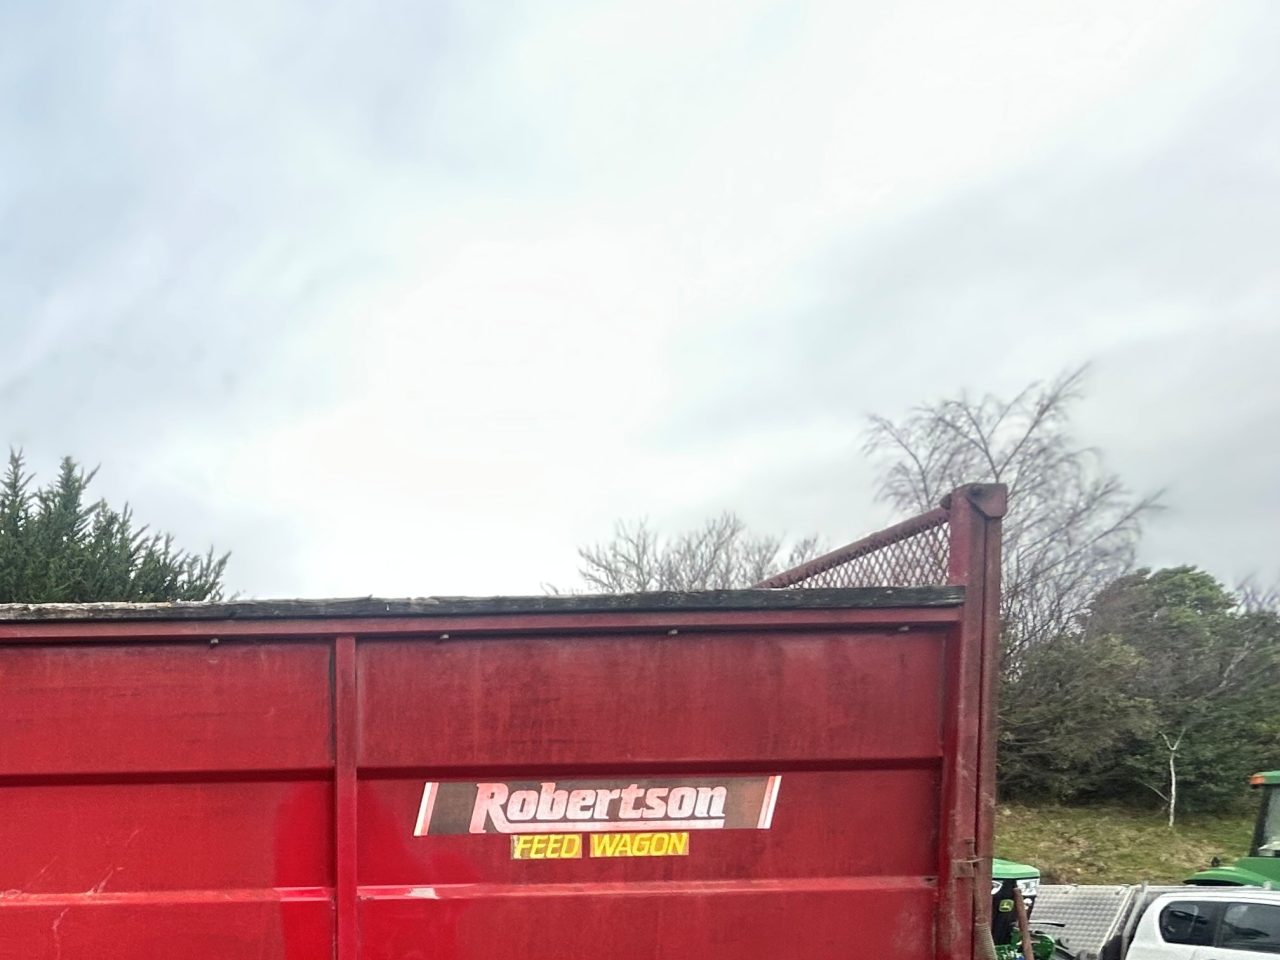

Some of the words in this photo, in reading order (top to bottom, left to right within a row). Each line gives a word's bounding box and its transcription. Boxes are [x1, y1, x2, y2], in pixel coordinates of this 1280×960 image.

[469, 782, 728, 834] Robertson
[513, 834, 580, 859] FEED
[593, 833, 687, 857] WAGON
